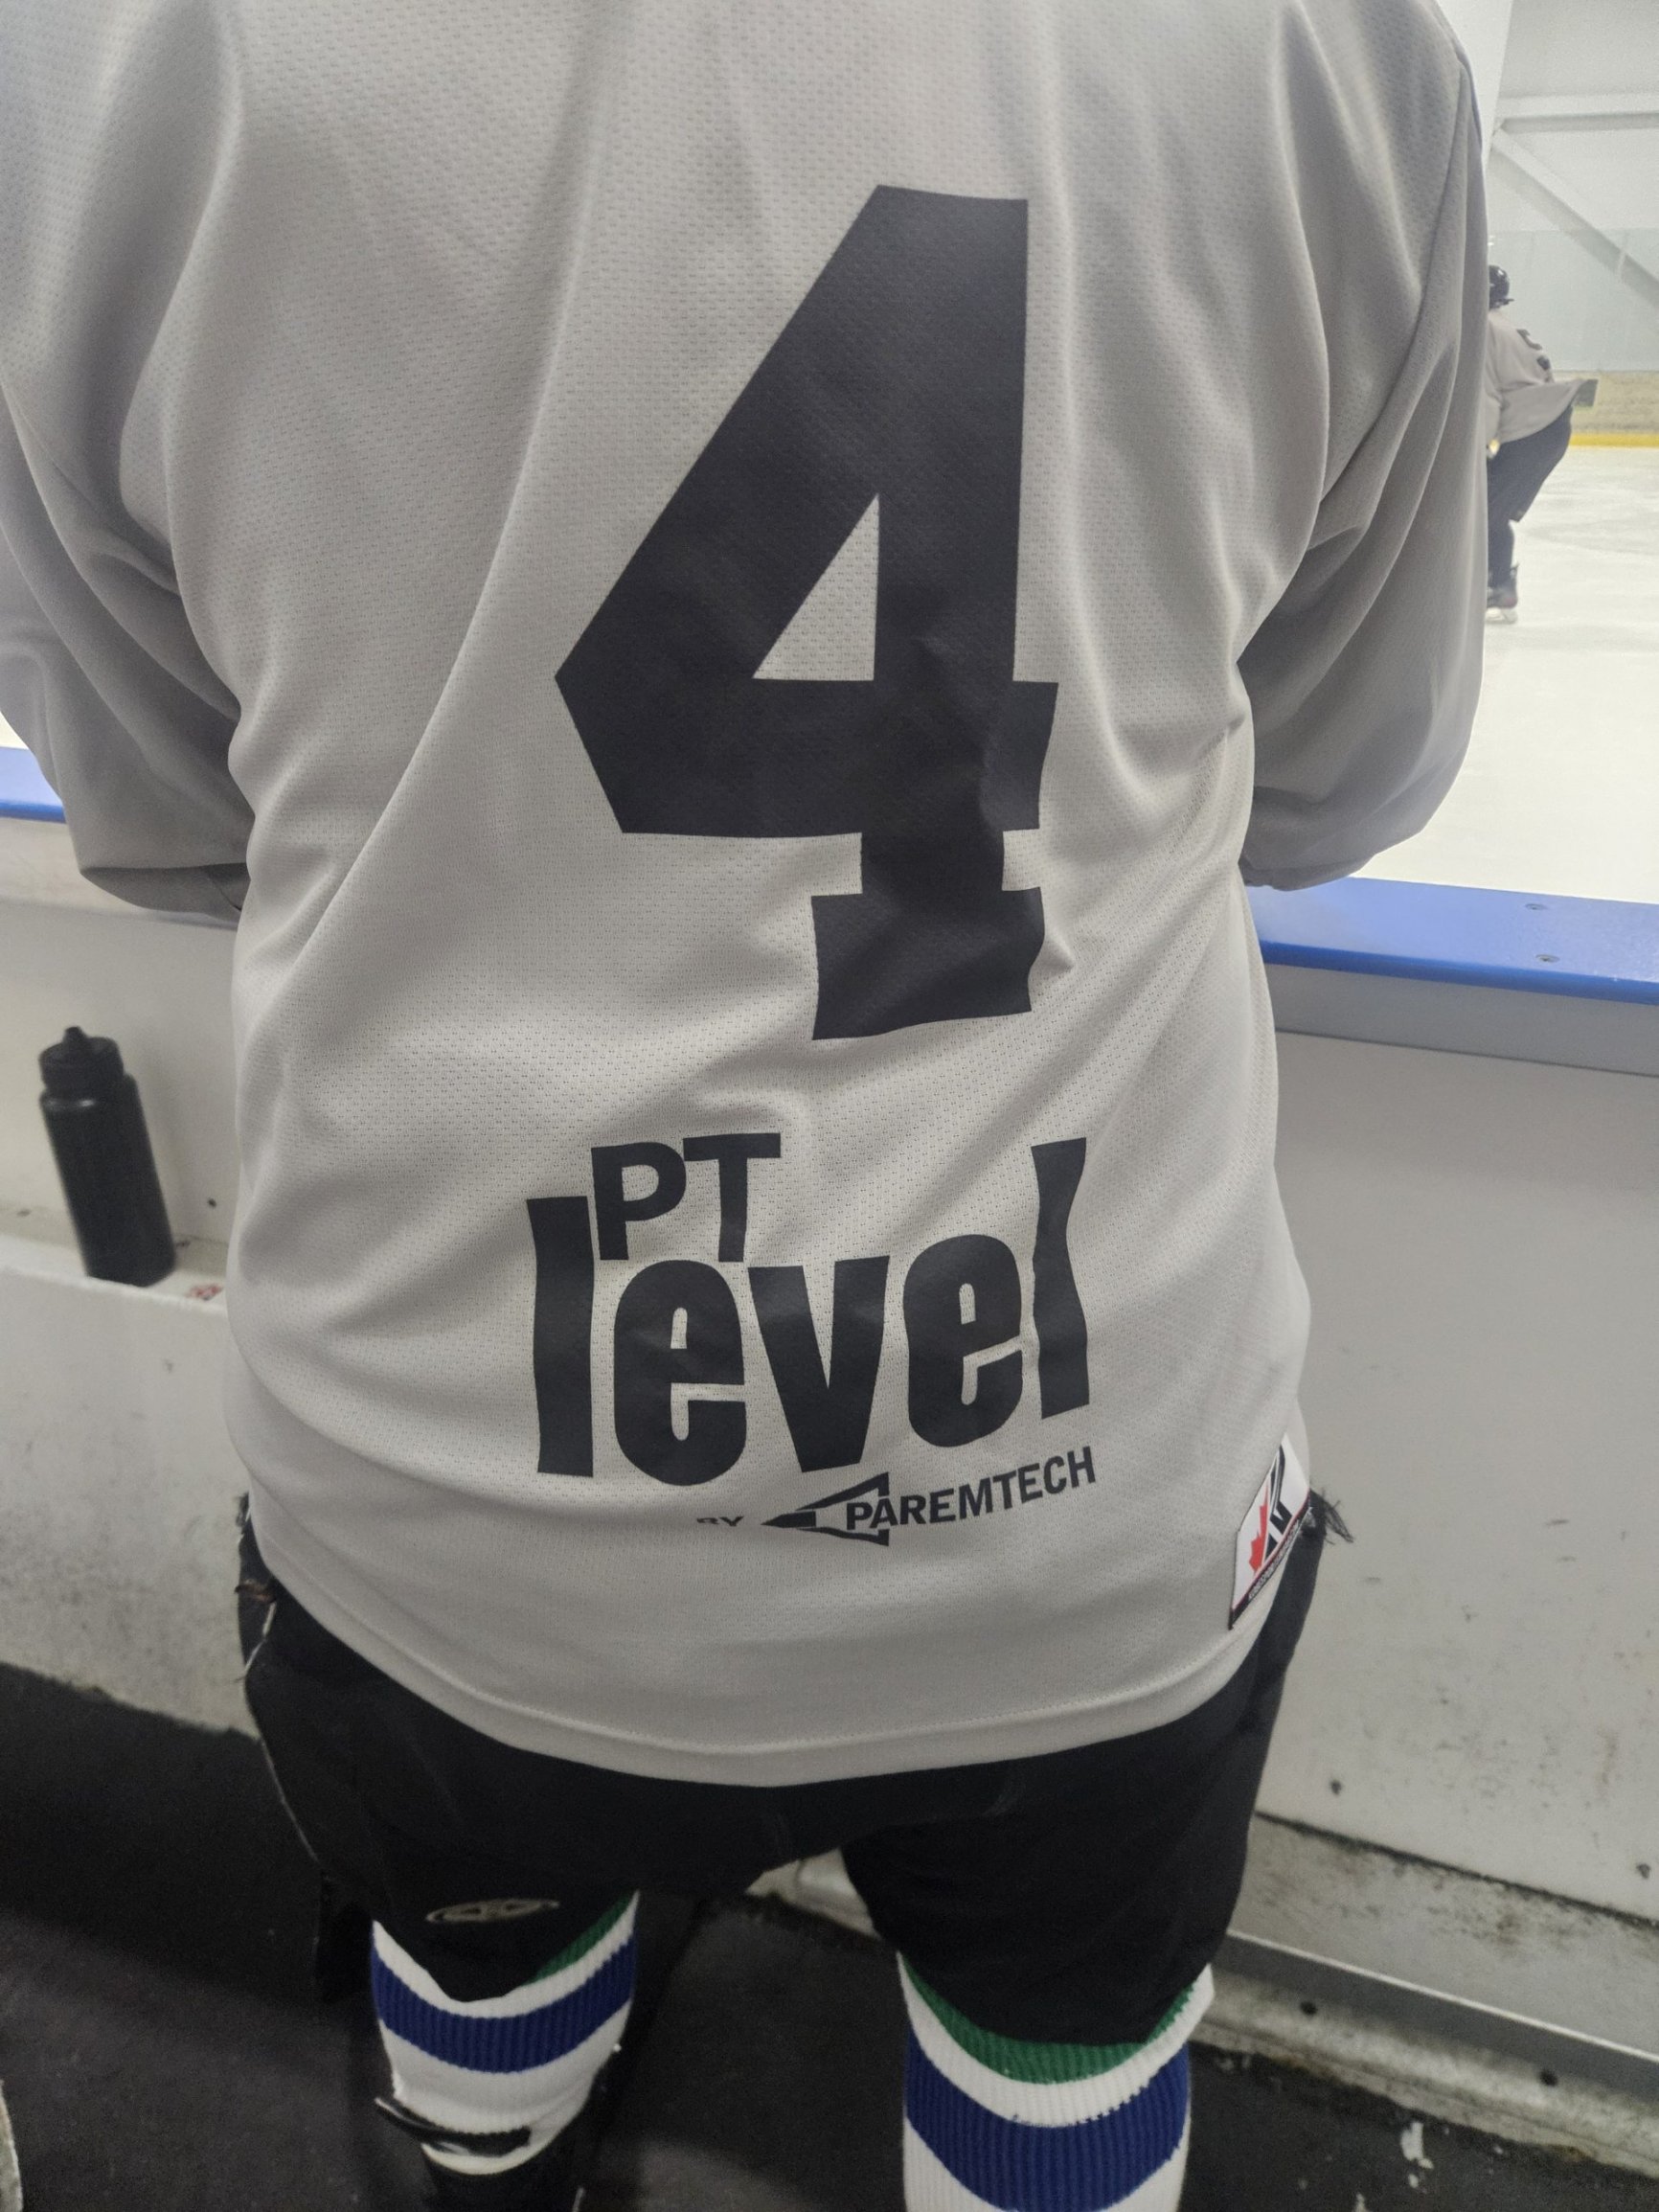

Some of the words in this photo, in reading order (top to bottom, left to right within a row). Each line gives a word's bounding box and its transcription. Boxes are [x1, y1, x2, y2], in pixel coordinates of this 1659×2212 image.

[555, 184, 1058, 1040] 4
[526, 1137, 1090, 1487] level
[591, 1132, 781, 1262] PT
[846, 1446, 1096, 1531] PAREMTECH
